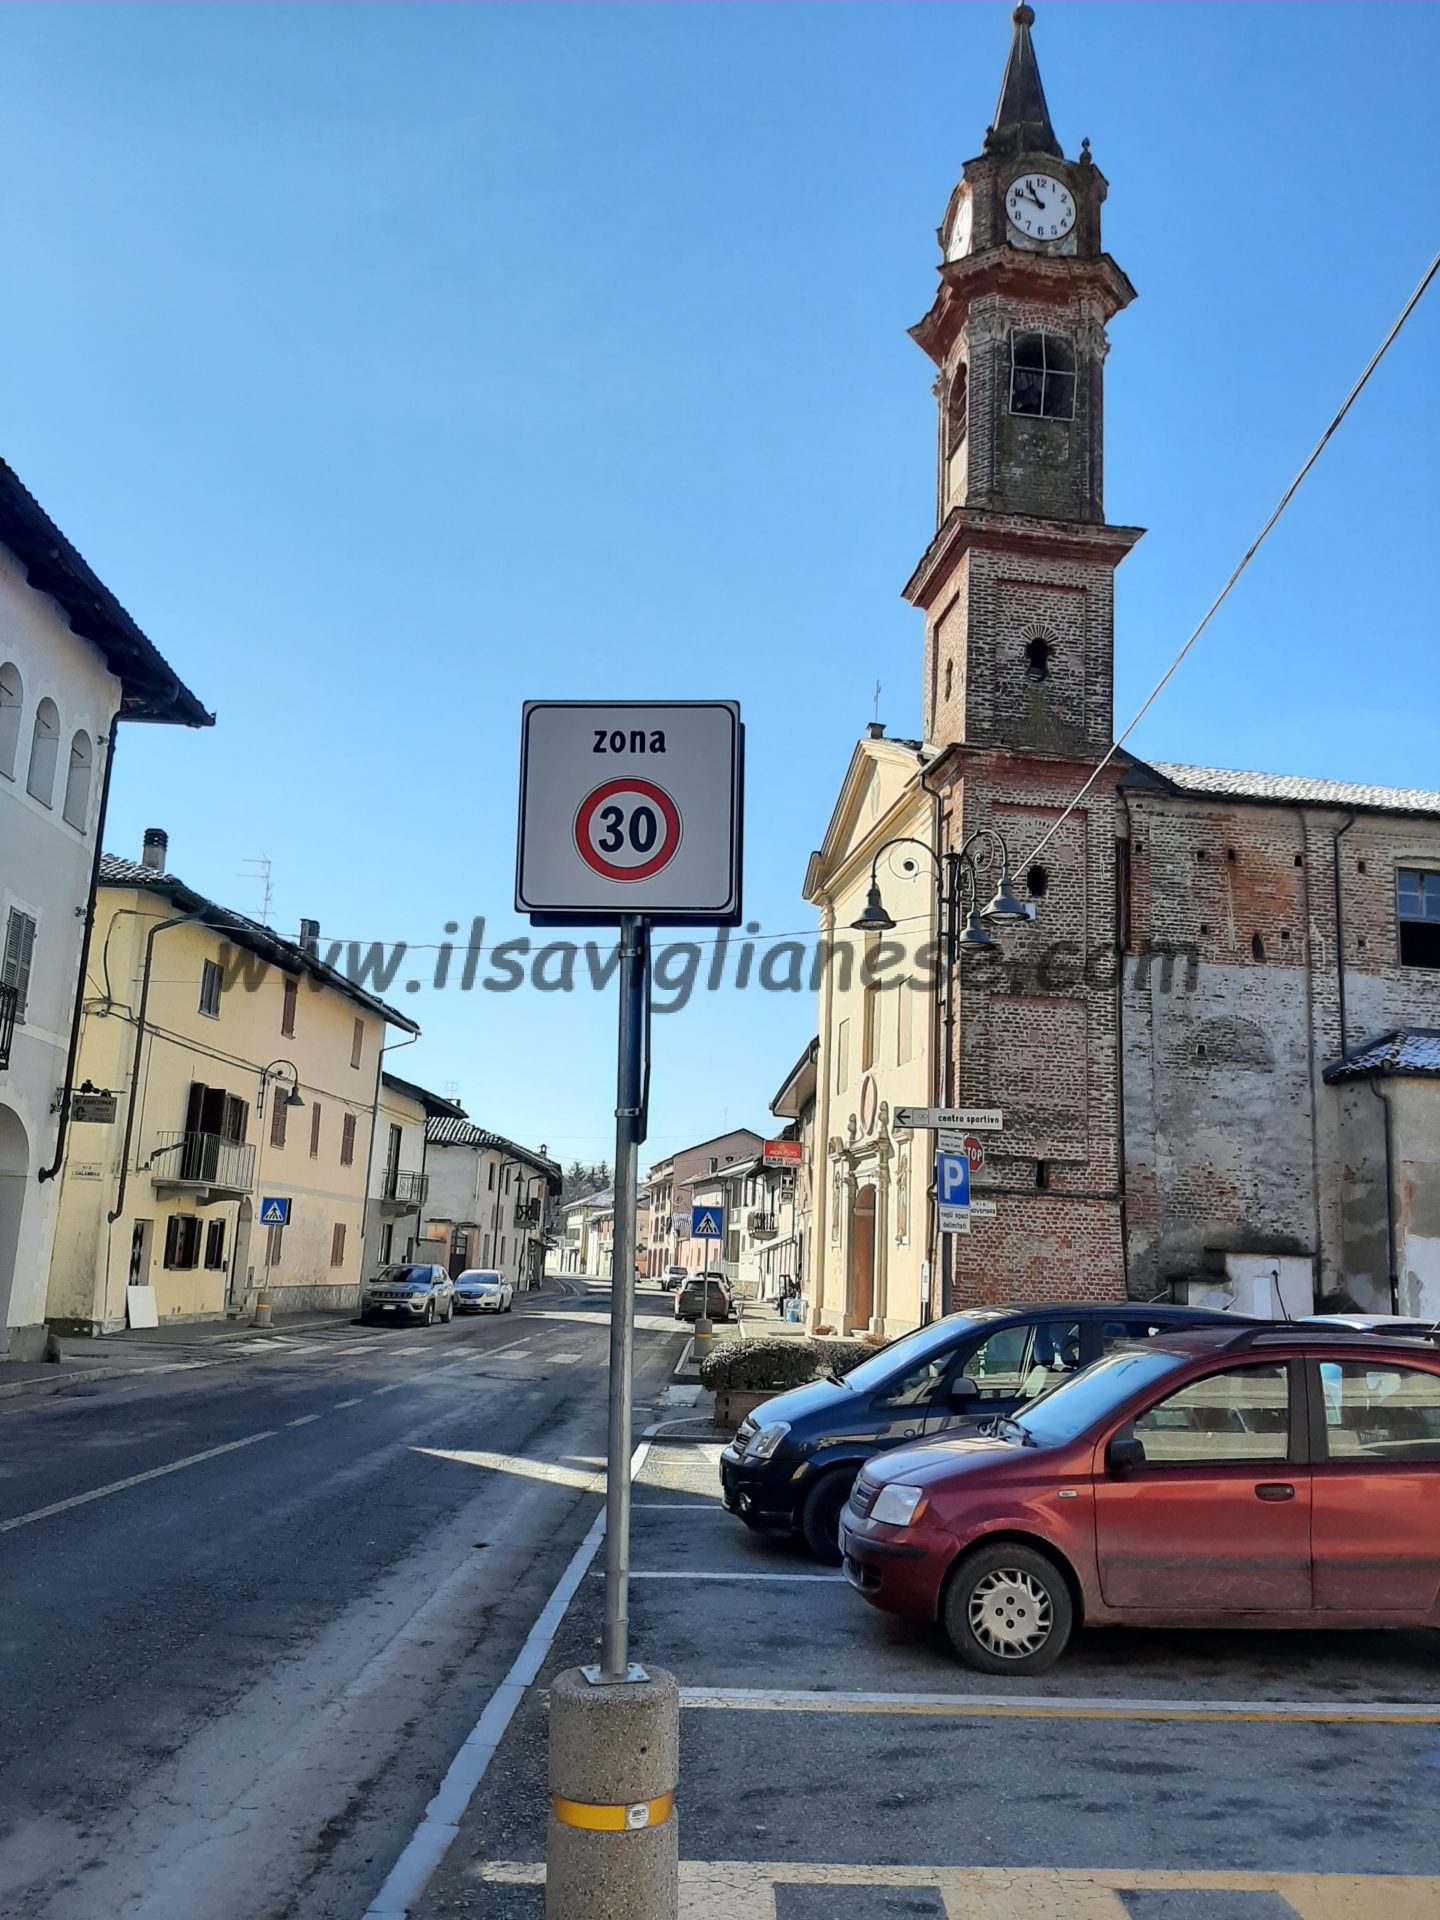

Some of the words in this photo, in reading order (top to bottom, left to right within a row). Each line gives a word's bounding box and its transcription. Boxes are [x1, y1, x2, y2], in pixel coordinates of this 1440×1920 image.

[1037, 178, 1047, 188] 12
[1015, 188, 1024, 198] 10
[1061, 193, 1067, 203] 2
[1010, 197, 1017, 208] 9
[1015, 210, 1021, 220] 8
[1066, 207, 1072, 217] 3
[1025, 220, 1031, 231] 7
[1060, 217, 1067, 228] 4
[1037, 226, 1044, 236] 6
[1051, 225, 1058, 235] 5
[592, 730, 667, 753] zona
[598, 805, 657, 853] 30
[938, 1114, 964, 1123] centro
[966, 1115, 1000, 1125] sportivo
[783, 1177, 793, 1188] T
[943, 1158, 963, 1200] P
